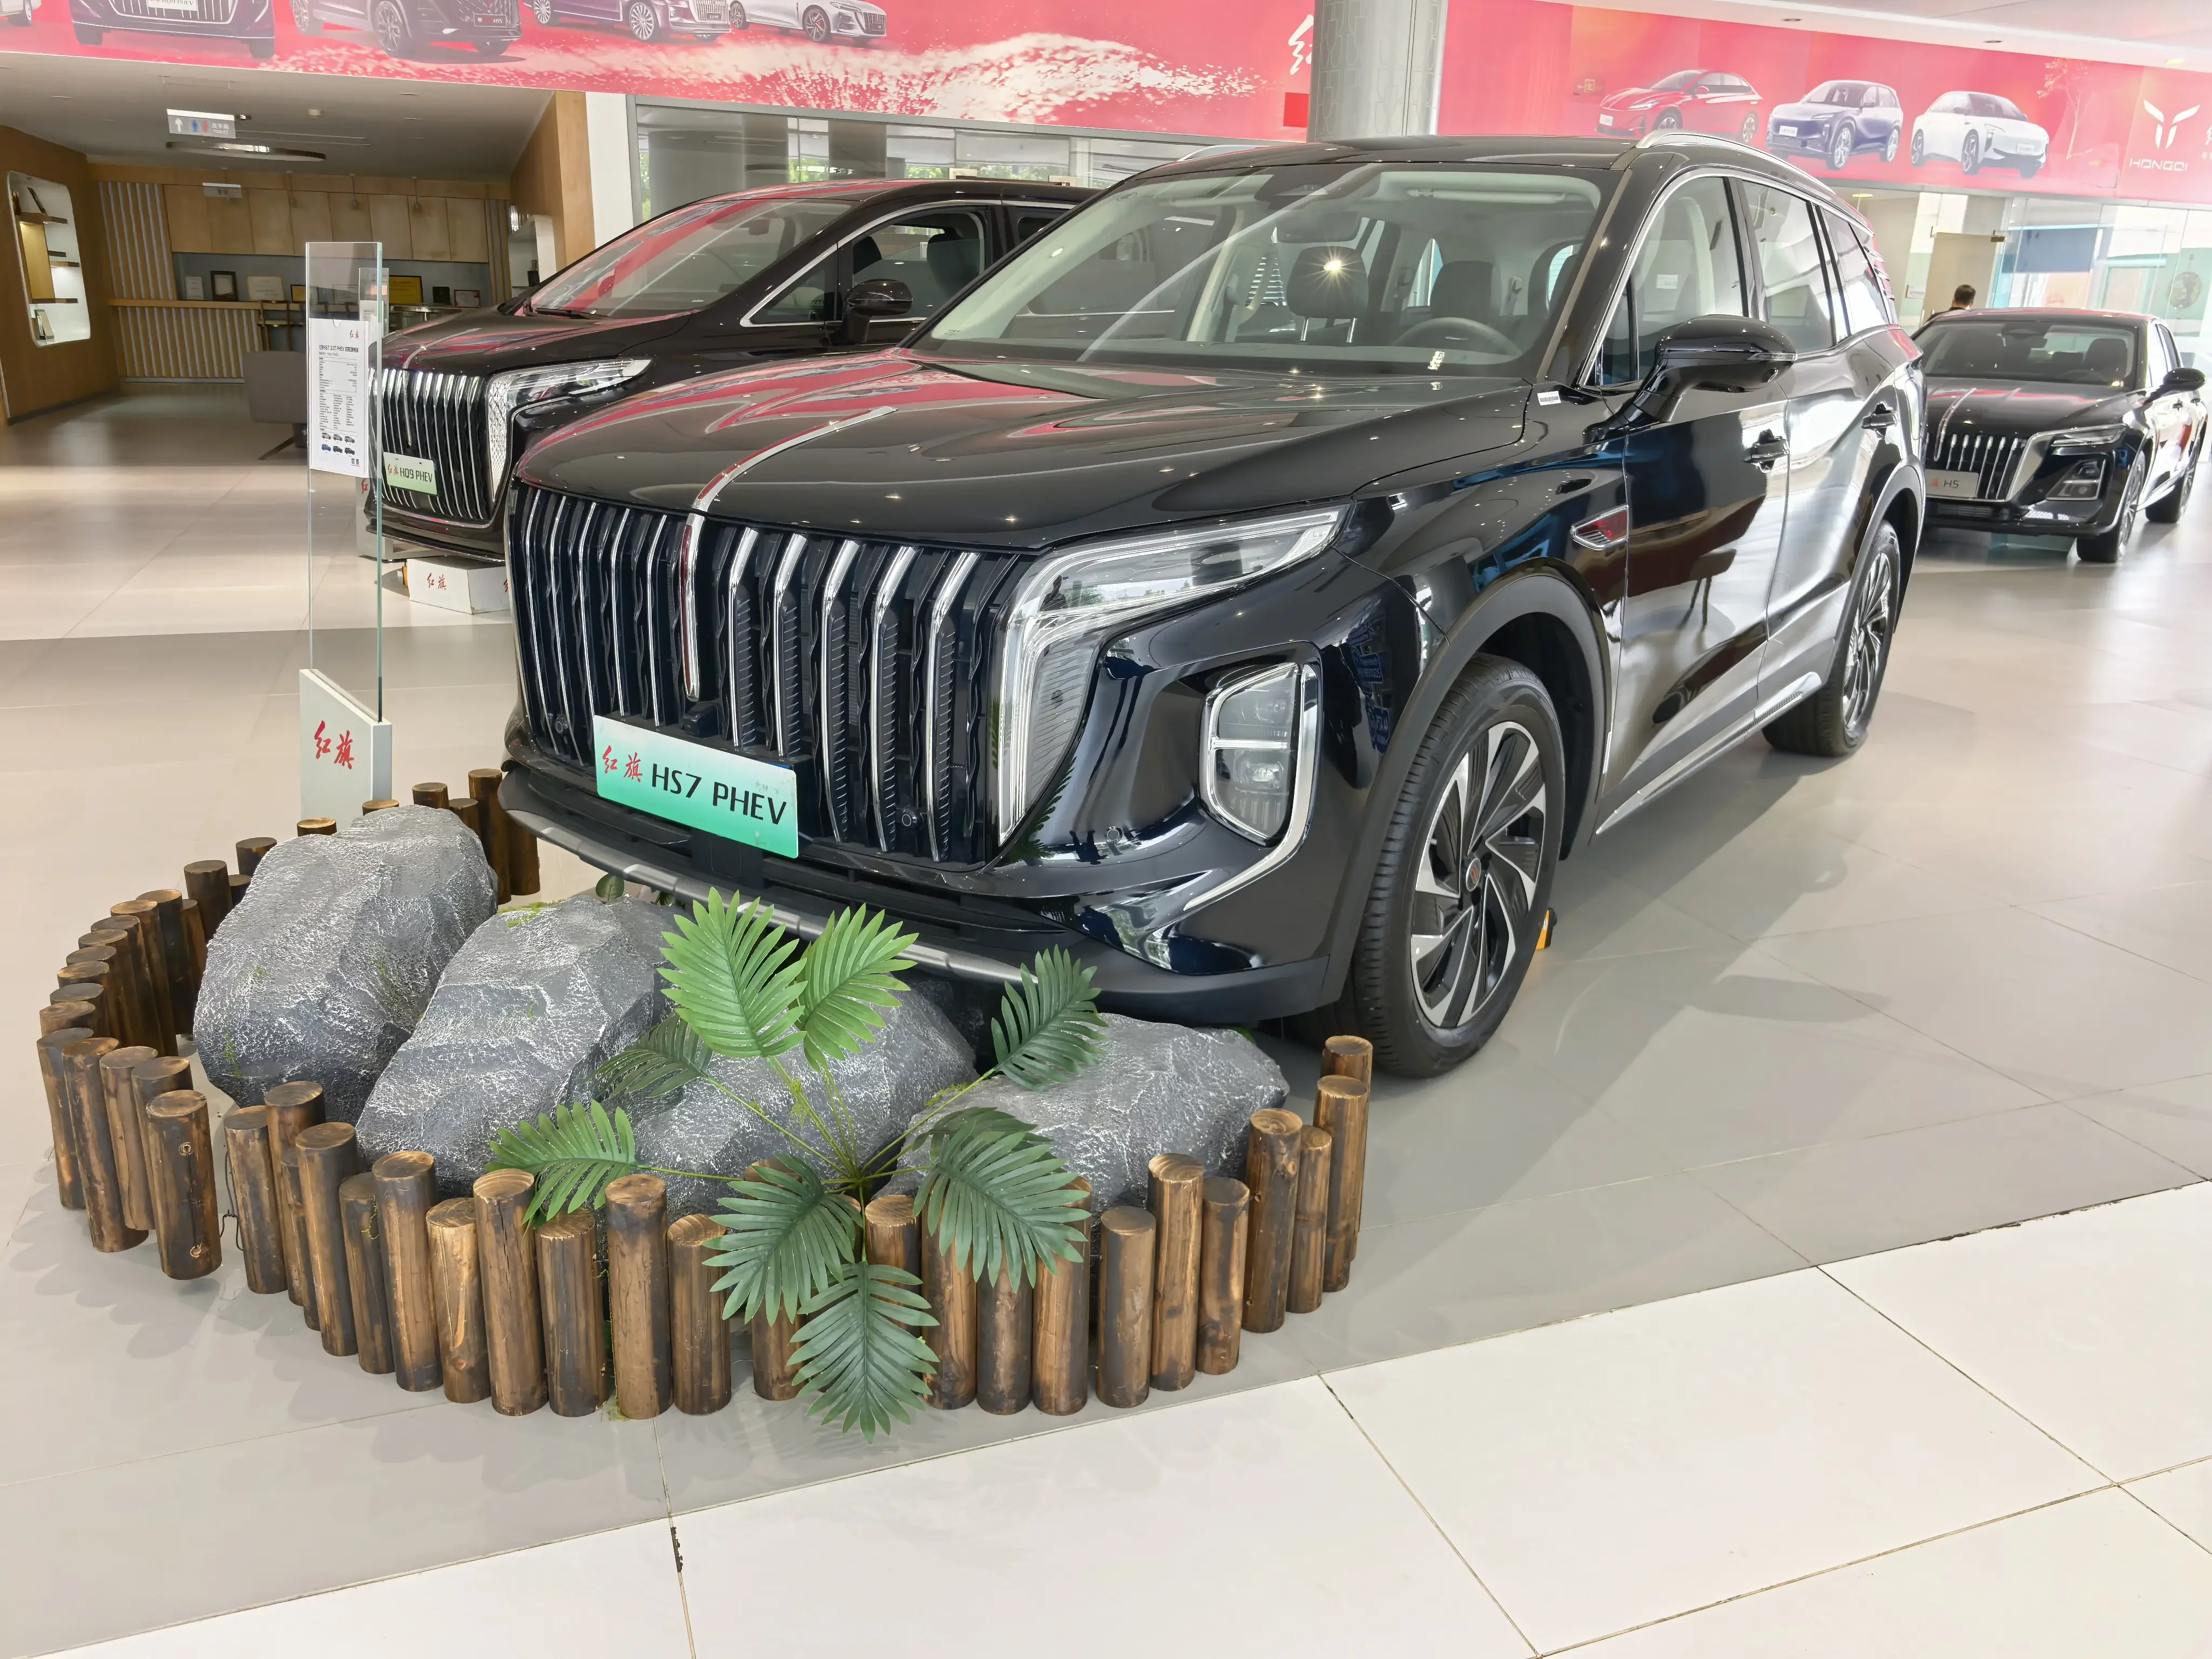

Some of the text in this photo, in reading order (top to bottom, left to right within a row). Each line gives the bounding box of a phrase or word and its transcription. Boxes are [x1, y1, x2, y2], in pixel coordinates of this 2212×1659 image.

[2129, 158, 2188, 172] HONGQI
[388, 463, 433, 483] 红旗 HQ9 PHEV
[1944, 479, 1959, 488] H5
[427, 572, 447, 590] 红旗
[314, 720, 354, 769] 红旗
[602, 745, 787, 825] 红旗 HS7 PHEV
